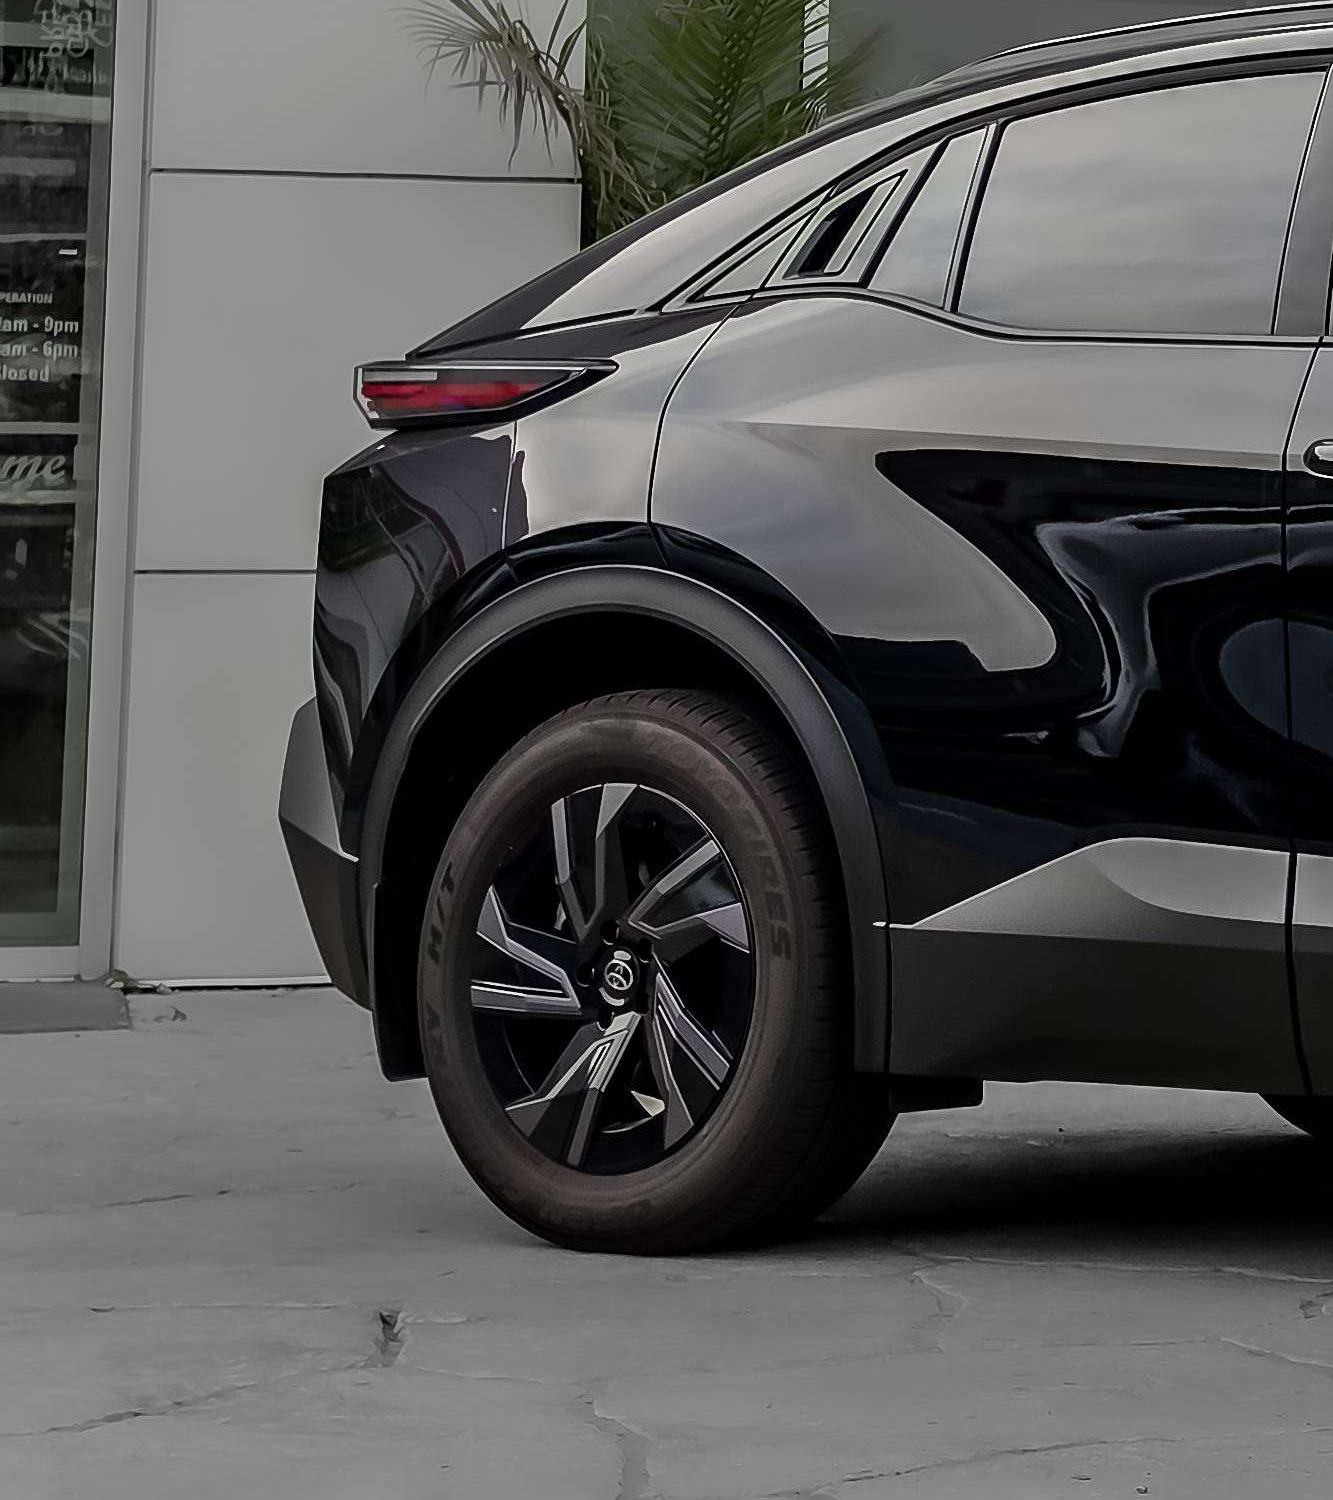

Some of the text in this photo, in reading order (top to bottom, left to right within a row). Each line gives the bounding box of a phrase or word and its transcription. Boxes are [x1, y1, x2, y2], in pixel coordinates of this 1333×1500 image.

[0, 316, 28, 332] am
[44, 315, 79, 337] 9pm
[43, 341, 78, 361] 6pm
[0, 364, 50, 382] losed
